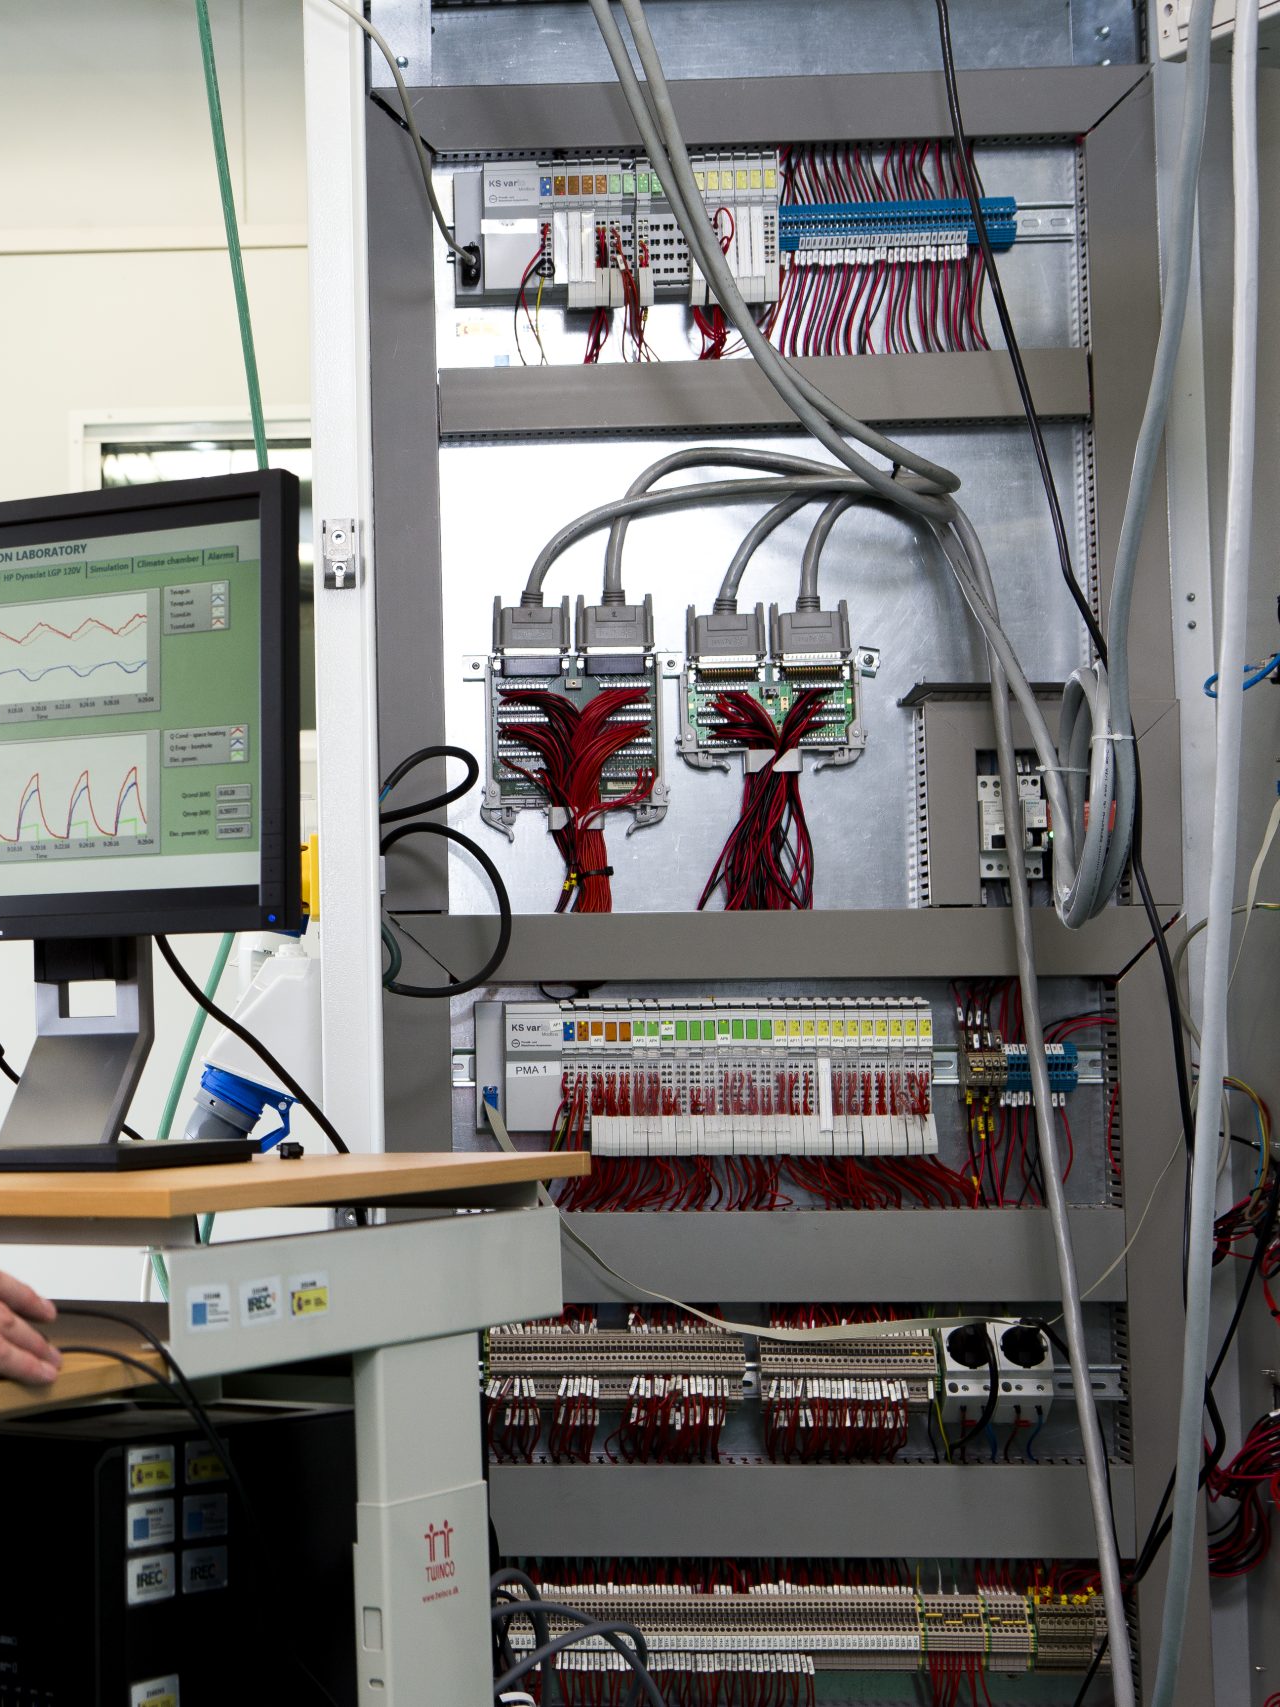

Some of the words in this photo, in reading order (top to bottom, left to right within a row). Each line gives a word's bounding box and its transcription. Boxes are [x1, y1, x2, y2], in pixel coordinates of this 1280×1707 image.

[16, 543, 87, 561] LABORATORY
[208, 551, 234, 561] Alarms
[90, 562, 129, 574] Simulation
[137, 558, 166, 569] Climate
[167, 555, 200, 566] chamber
[4, 573, 14, 582] HP
[48, 568, 62, 578] LGP
[515, 1067, 539, 1075] PMA
[137, 1568, 163, 1588] IREC
[190, 1563, 215, 1581] IREC
[425, 1560, 455, 1582] TWINCO
